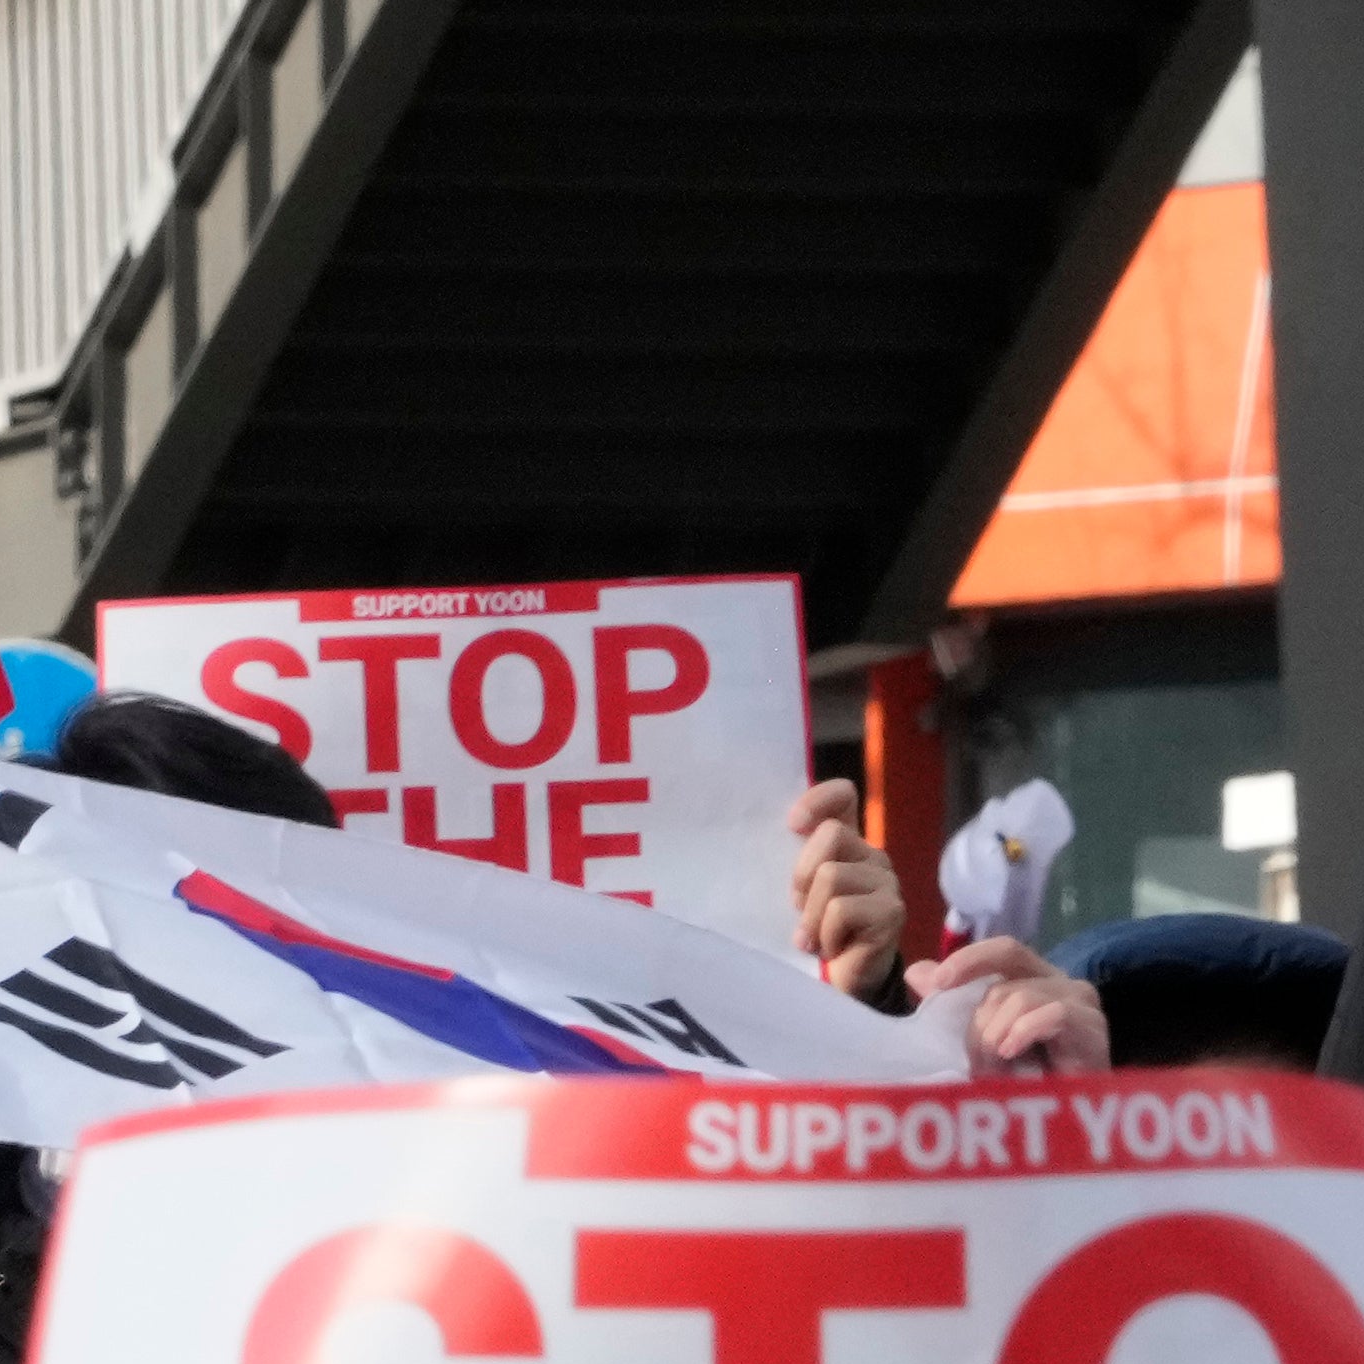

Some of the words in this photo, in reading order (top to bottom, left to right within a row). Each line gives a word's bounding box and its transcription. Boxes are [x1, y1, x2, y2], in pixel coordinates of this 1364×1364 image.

[353, 593, 469, 617] SUPPORT
[474, 589, 546, 613] YOON
[200, 624, 711, 774] STOP
[684, 1097, 1060, 1173] SUPPORT
[1071, 1091, 1277, 1165] YOON
